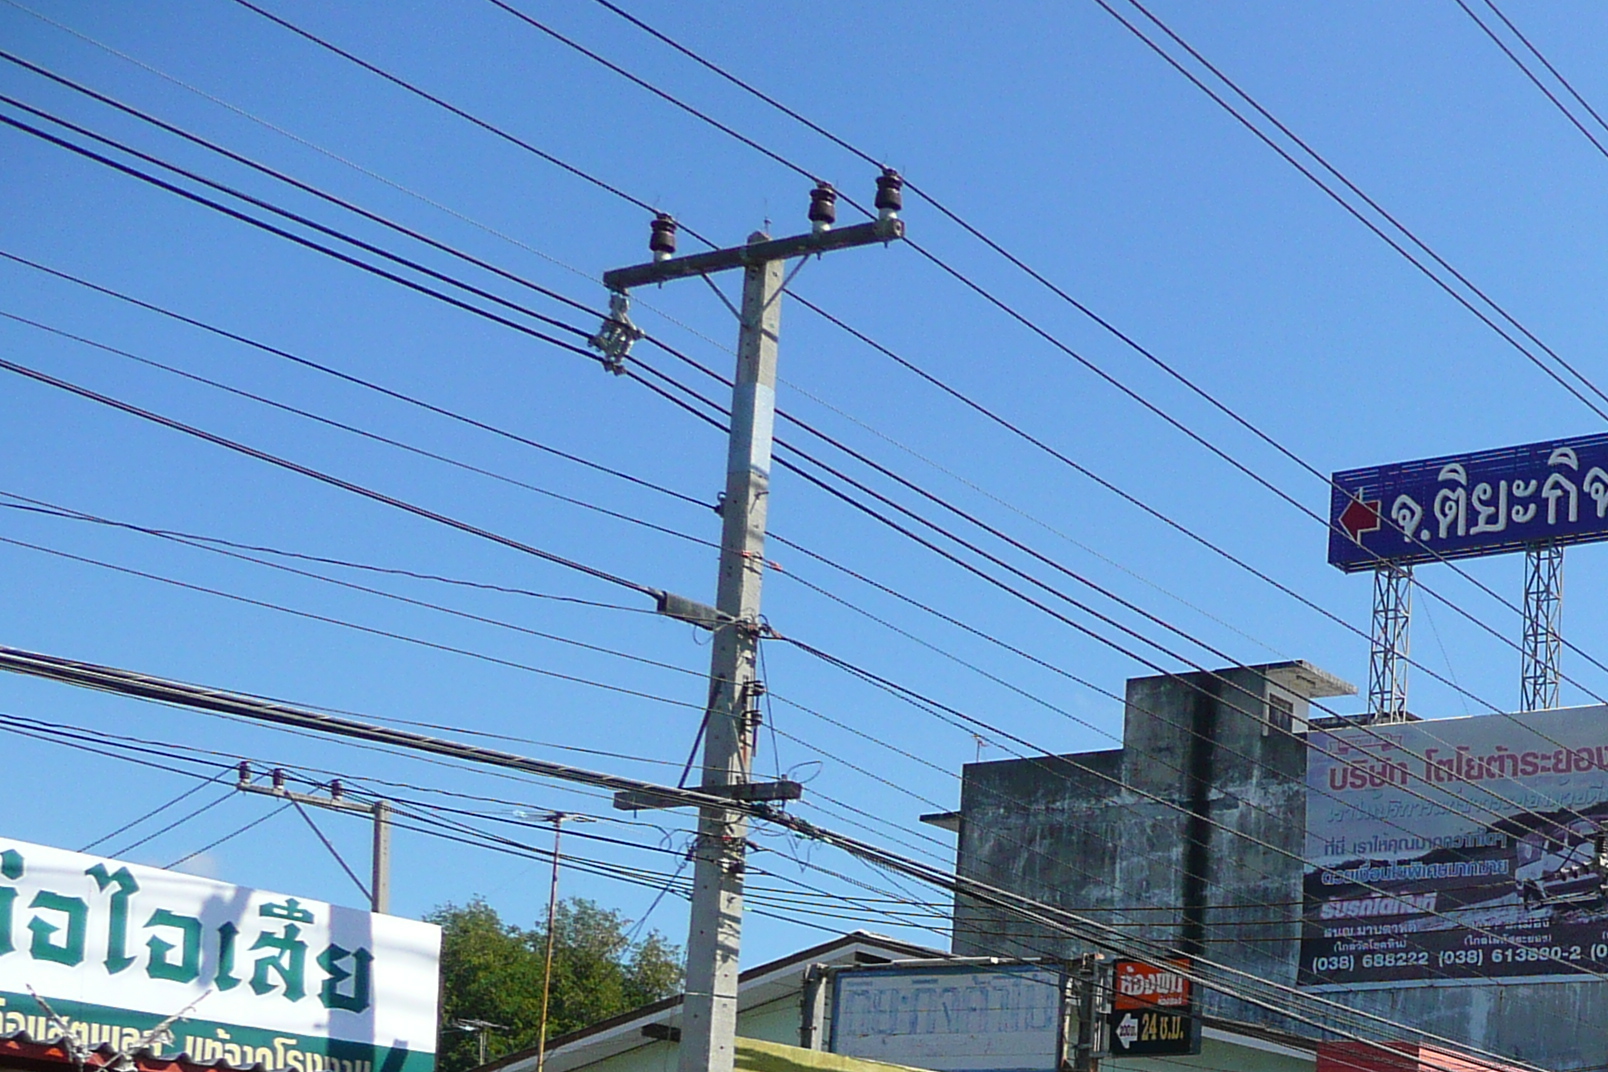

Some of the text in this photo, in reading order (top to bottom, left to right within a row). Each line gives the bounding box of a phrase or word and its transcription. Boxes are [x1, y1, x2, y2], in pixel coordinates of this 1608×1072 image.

[1329, 757, 1408, 791] บริษัท
[1312, 951, 1430, 974] (038) 688222
[1438, 949, 1484, 967] (038)
[1141, 1012, 1158, 1041] 24
